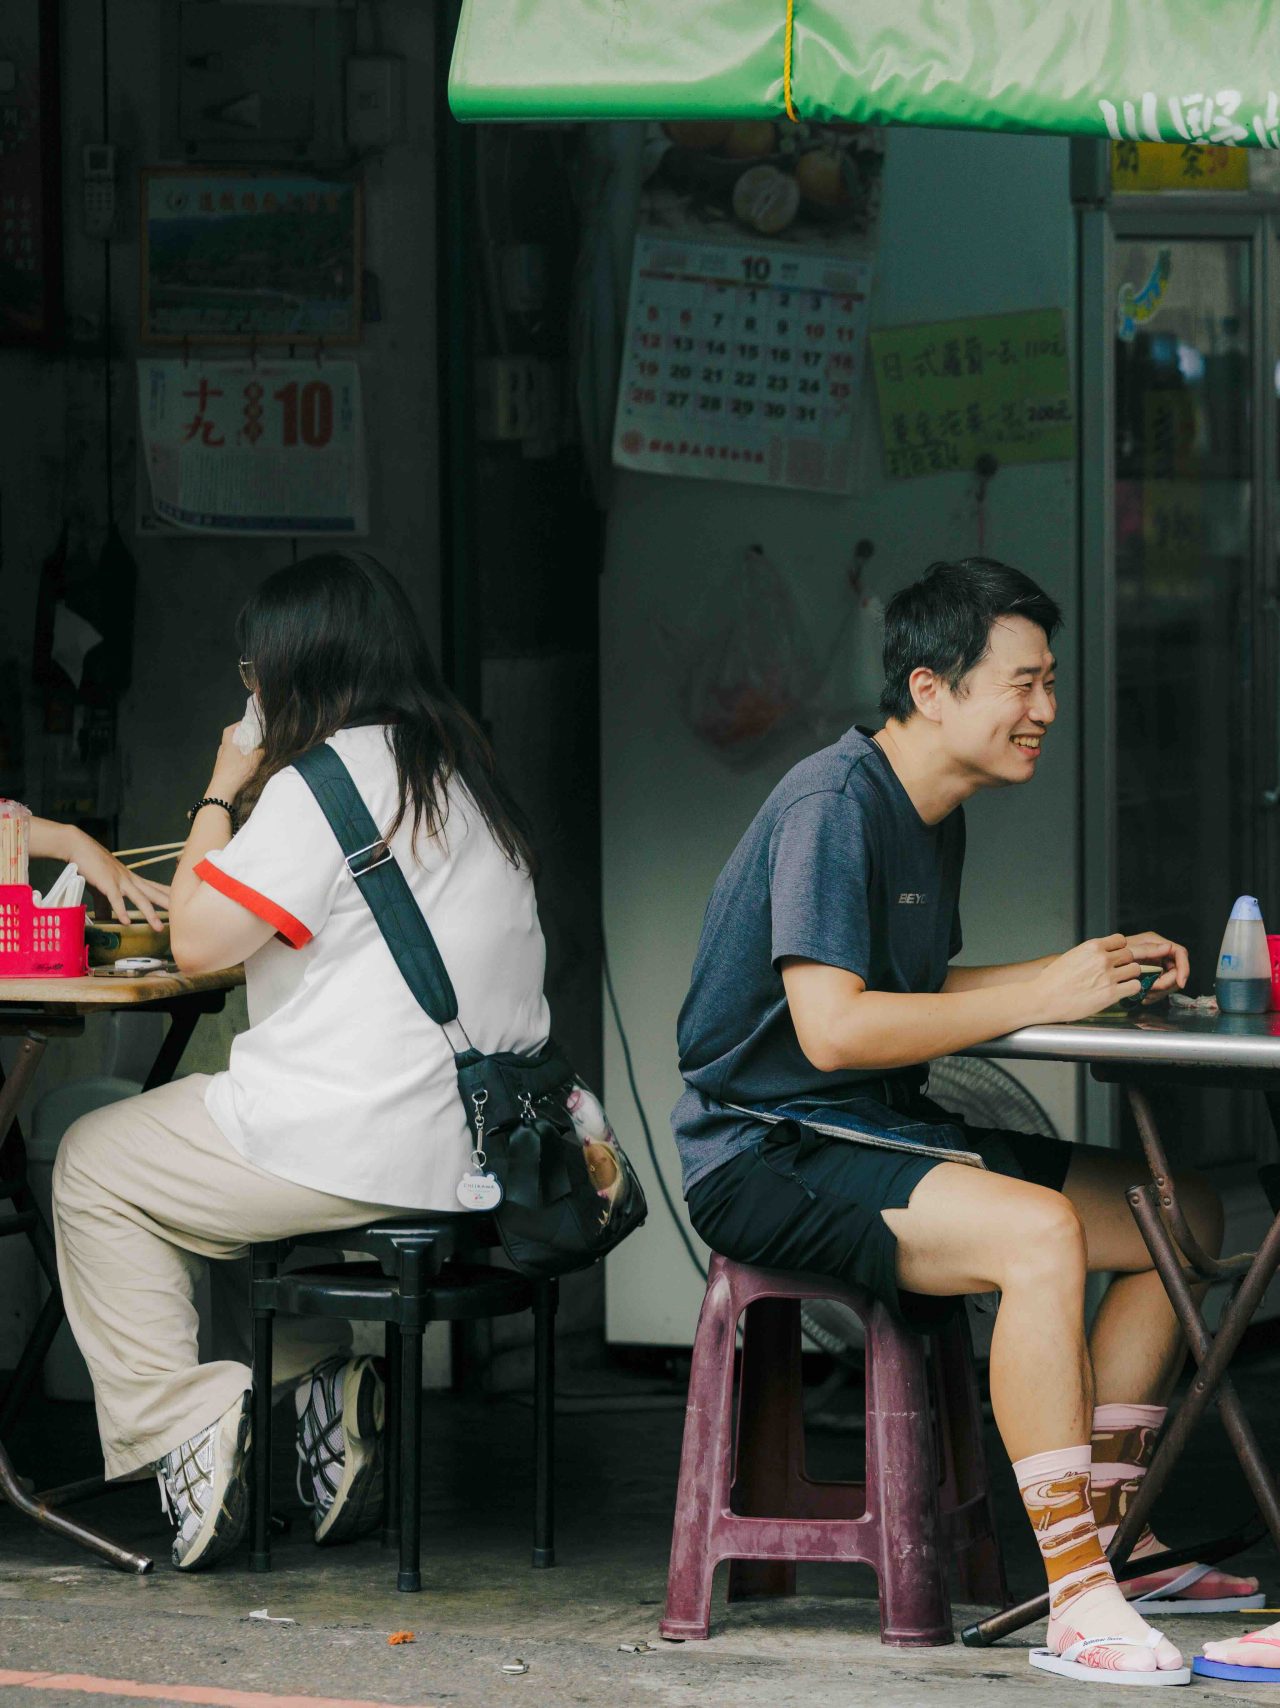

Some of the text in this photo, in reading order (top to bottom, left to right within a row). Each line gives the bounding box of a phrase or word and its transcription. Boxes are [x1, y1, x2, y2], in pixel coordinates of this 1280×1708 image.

[741, 256, 770, 280] 10
[749, 291, 756, 304] 1
[780, 293, 789, 306] 2
[713, 313, 723, 325] 7
[746, 317, 756, 330] 8
[777, 320, 787, 334] 9
[837, 327, 853, 341] 11
[641, 333, 660, 348] 12
[673, 336, 693, 351] 13
[706, 340, 725, 354] 14
[738, 343, 757, 358] 15
[771, 347, 789, 362] 16
[803, 351, 821, 365] 17
[639, 361, 657, 376] 19
[670, 364, 690, 378] 20
[703, 368, 722, 382] 21
[735, 372, 755, 386] 22
[767, 375, 787, 391] 23
[799, 379, 819, 393] 24
[273, 379, 334, 448] 10
[633, 388, 654, 403] 26
[667, 393, 688, 407] 27
[732, 399, 753, 415] 29
[765, 403, 784, 418] 30
[798, 406, 815, 421] 31
